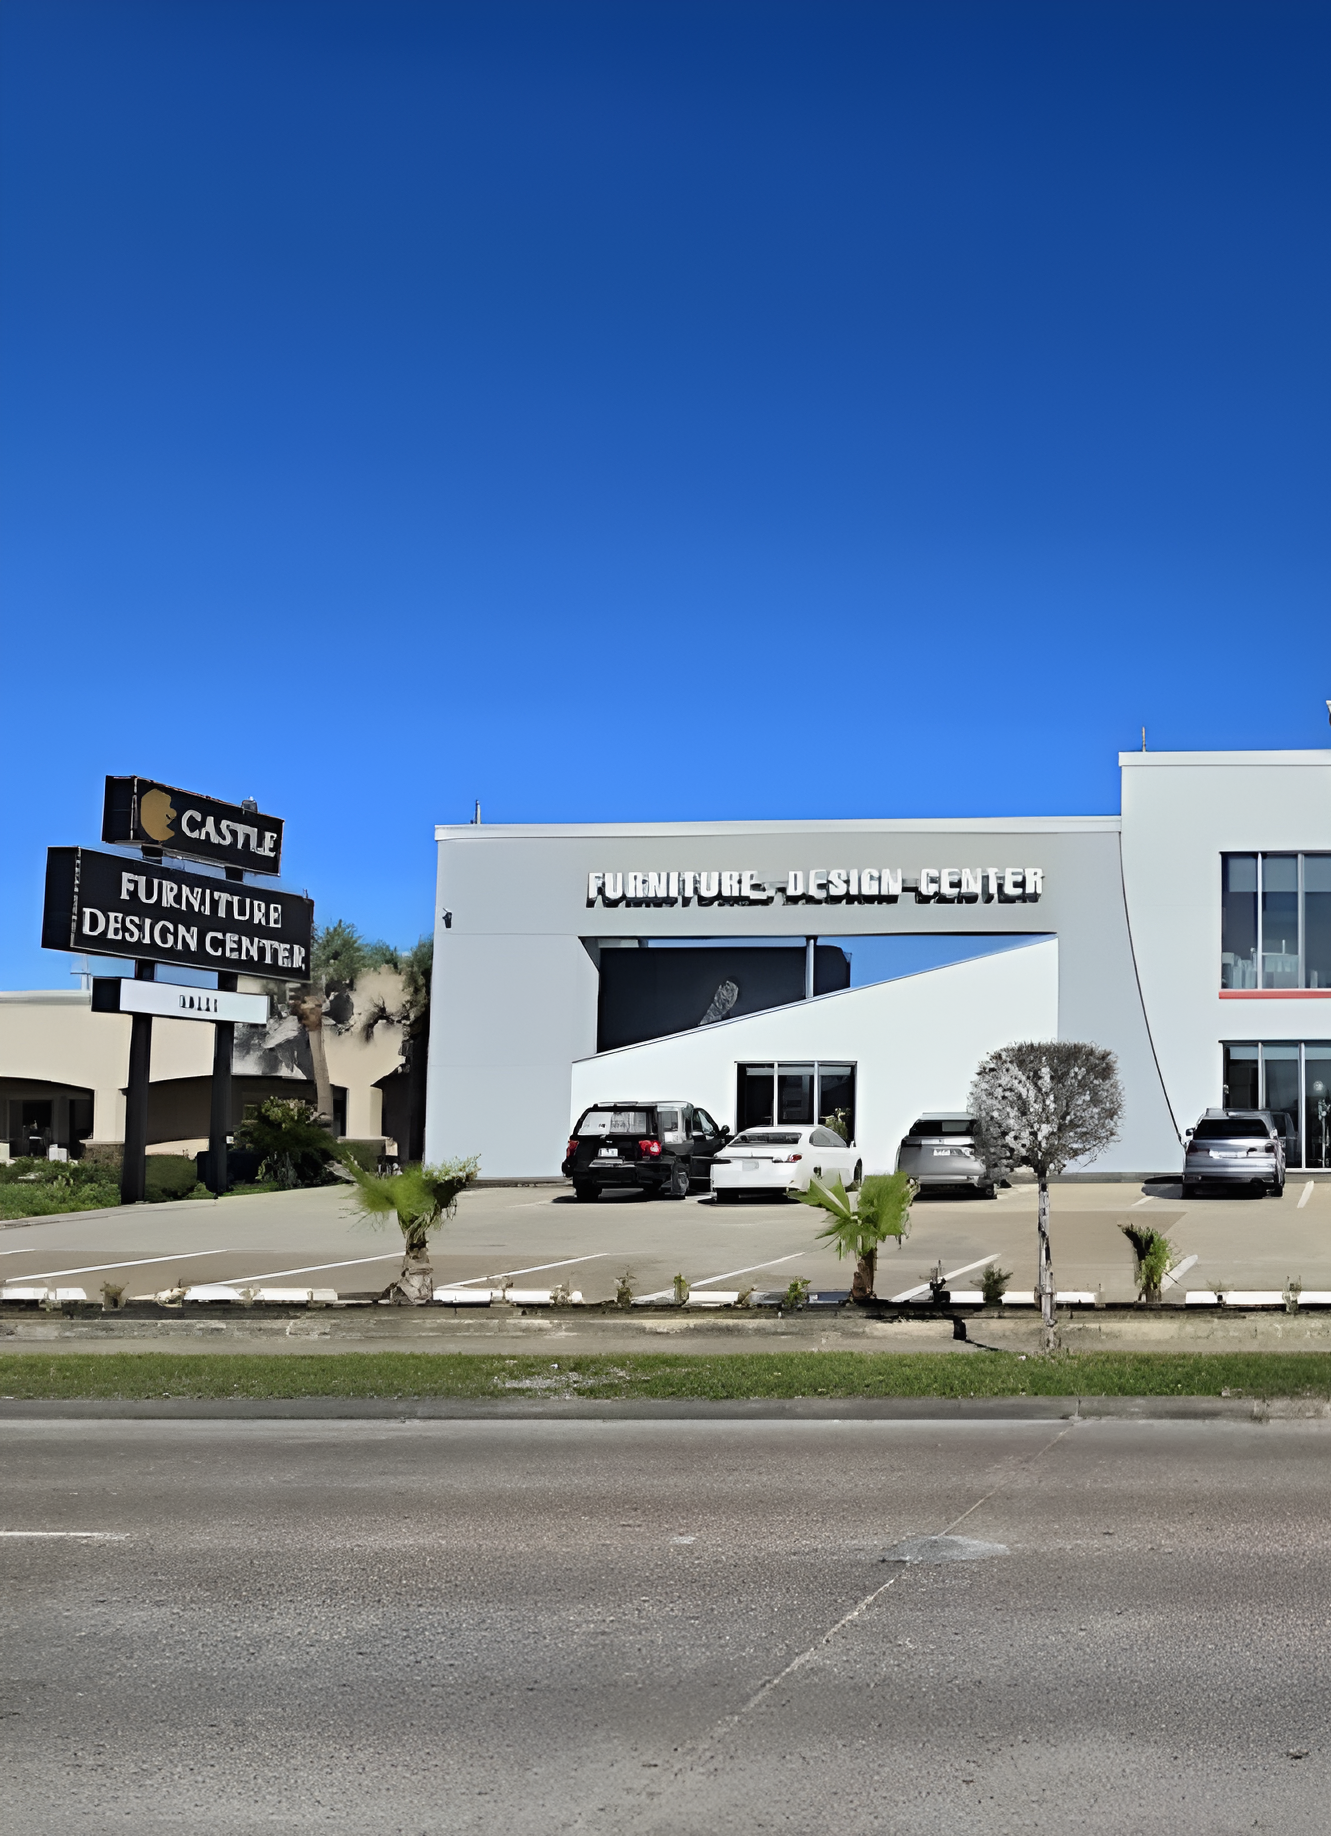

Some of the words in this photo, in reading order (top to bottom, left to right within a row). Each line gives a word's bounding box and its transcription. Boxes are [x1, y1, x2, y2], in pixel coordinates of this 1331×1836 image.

[181, 809, 278, 857] CASTLE
[119, 871, 282, 929] FURNITURE
[586, 870, 768, 905] FURNITURE
[786, 868, 903, 902] DESIGN
[919, 867, 1044, 902] CENTER
[82, 907, 198, 952] DESIGN
[205, 931, 306, 971] CENTER
